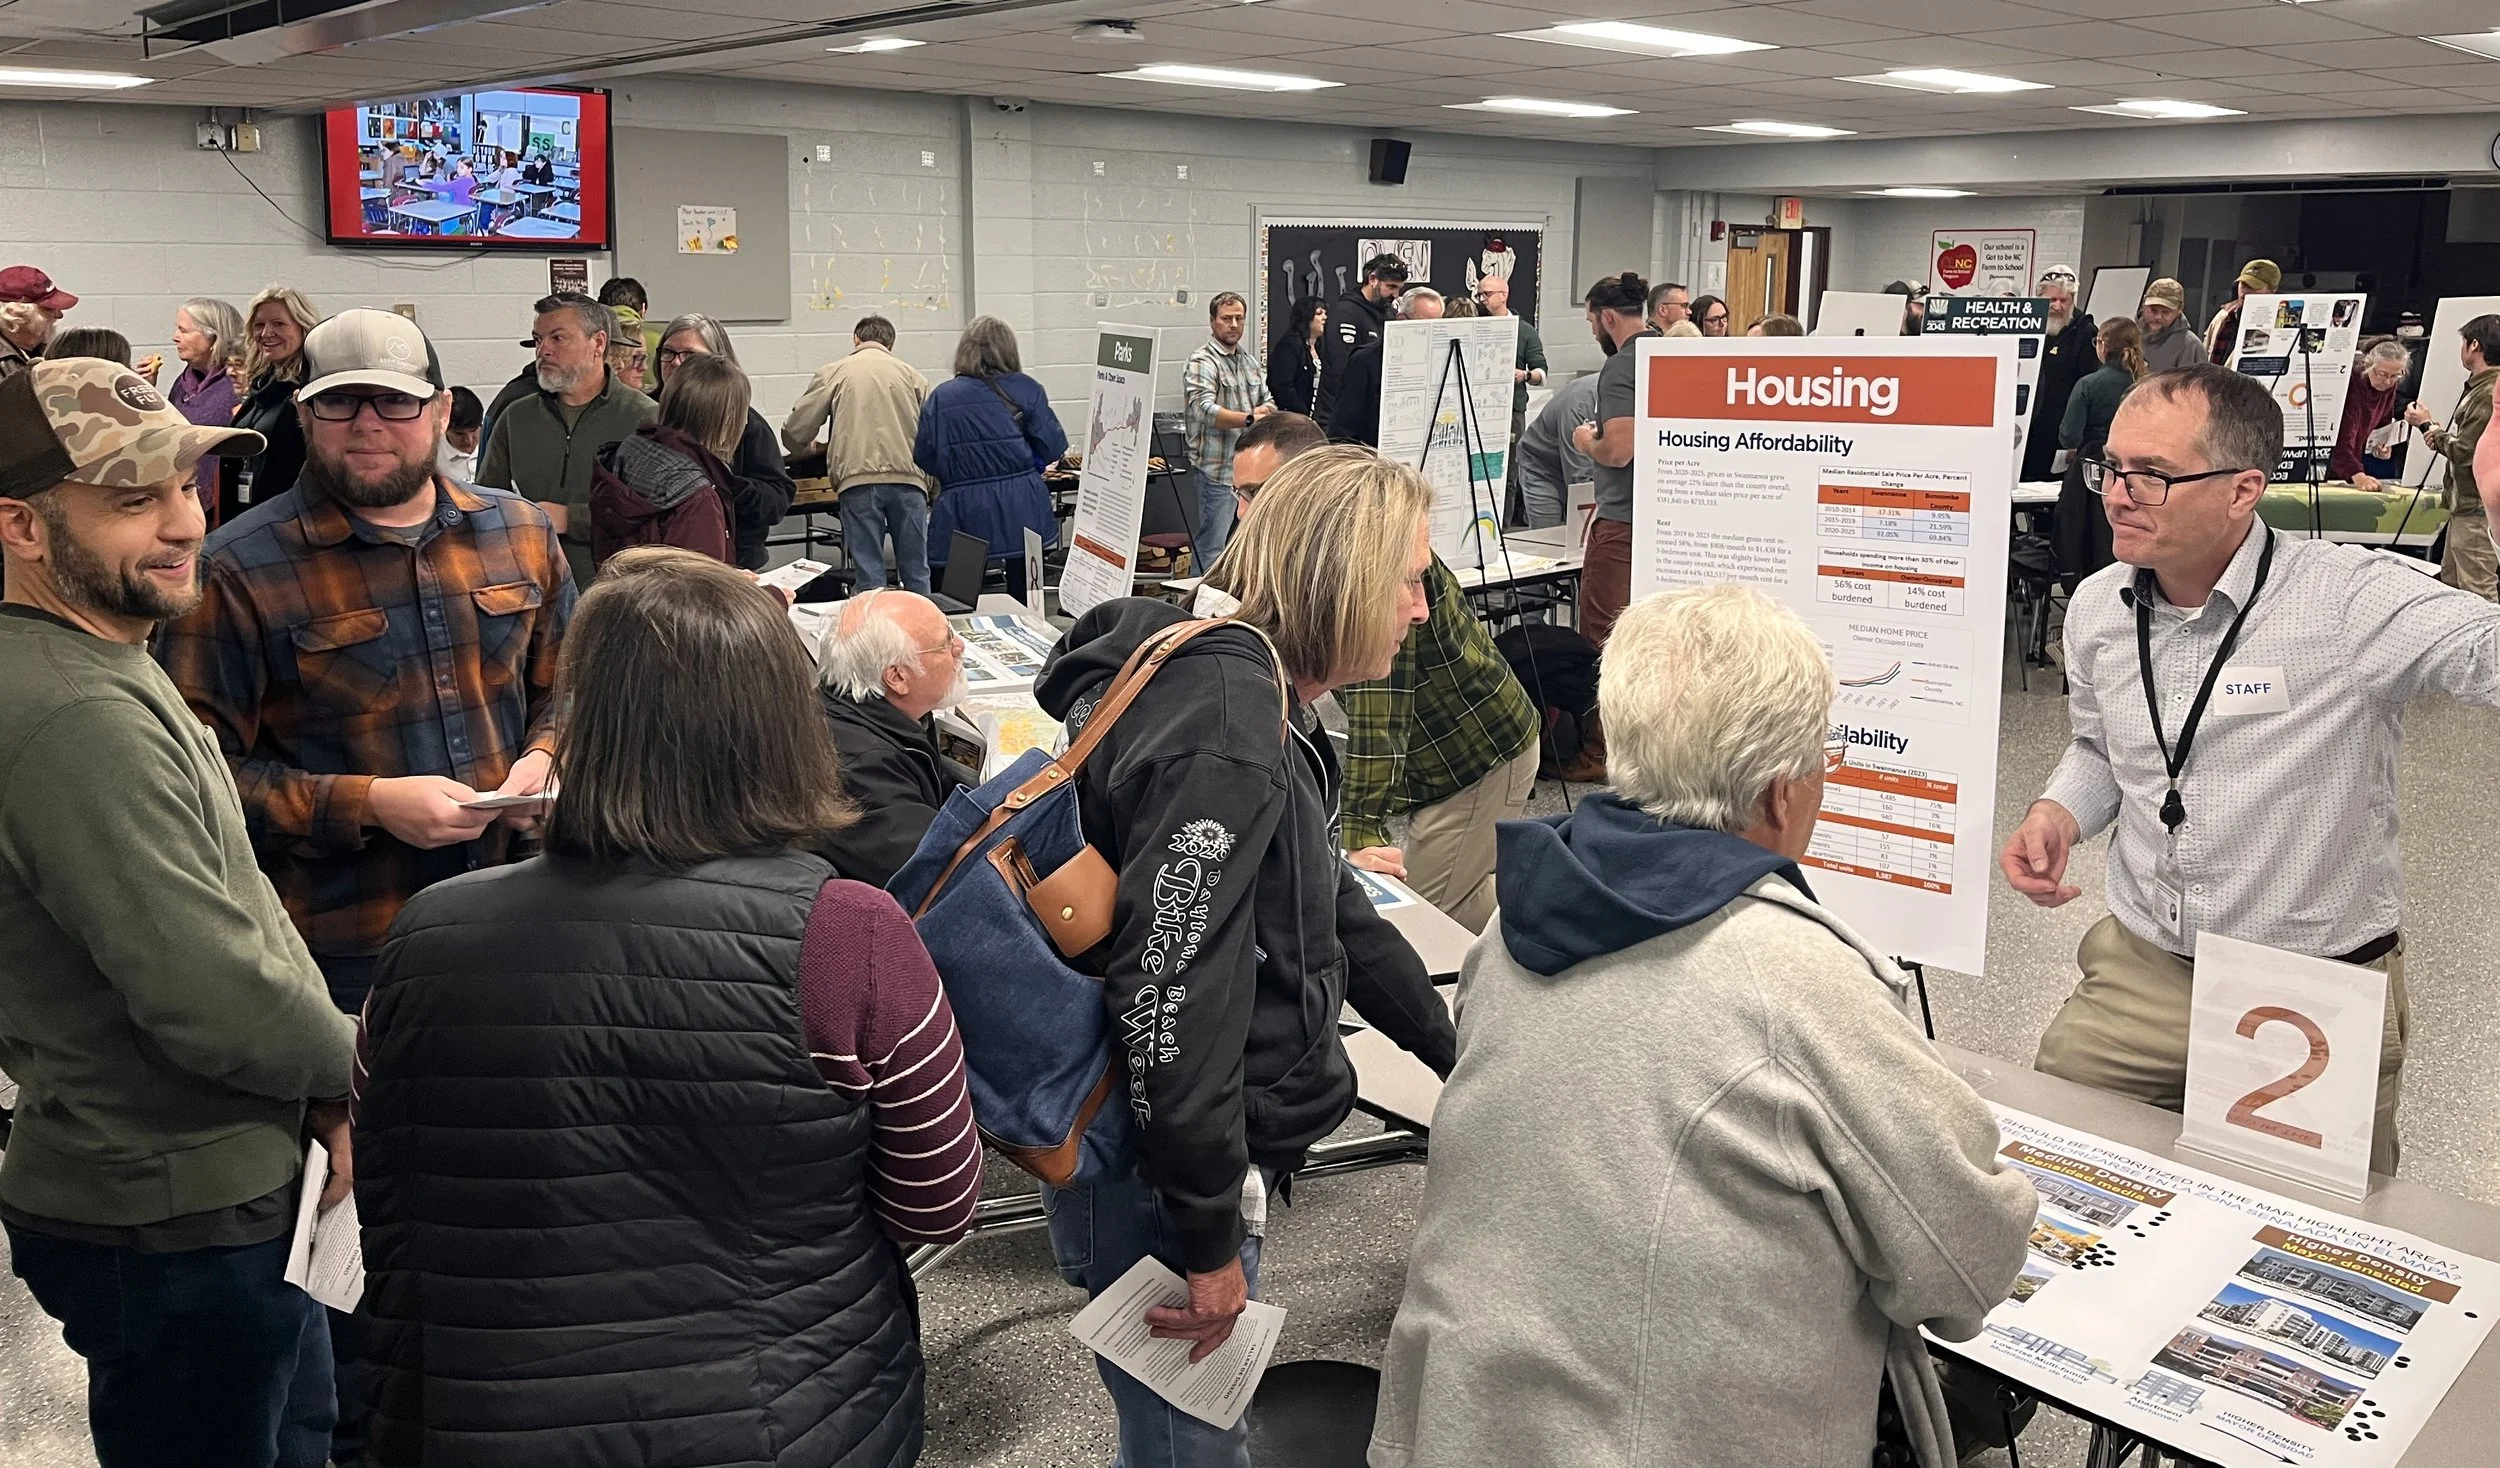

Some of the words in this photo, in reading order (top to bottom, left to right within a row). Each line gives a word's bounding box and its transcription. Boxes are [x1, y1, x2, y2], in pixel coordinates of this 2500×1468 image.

[1955, 259, 1972, 268] NC
[1965, 301, 2020, 314] HEALTH
[2022, 302, 2032, 314] &
[1952, 317, 2041, 329] RECREATION
[1114, 341, 1132, 363] Parks
[1727, 366, 1899, 416] Housing
[1658, 430, 1730, 451] Housing
[1735, 433, 1854, 456] Affordability
[1847, 469, 1880, 477] Residential
[1930, 503, 1953, 511] County
[1577, 504, 1596, 548] 7
[1823, 549, 1858, 557] Households
[1860, 552, 1886, 561] spending
[1905, 555, 1920, 563] than
[1862, 562, 1883, 570] income
[1894, 564, 1918, 573] housing
[1834, 579, 1852, 589] 56%
[1854, 582, 1872, 591] cost
[1907, 586, 1925, 596] 14%
[1927, 588, 1945, 598] cost
[1832, 592, 1873, 604] burdened
[1904, 600, 1947, 612] burdened
[1849, 623, 1879, 634] MEDIAN
[1880, 627, 1904, 637] HOME
[1905, 629, 1929, 639] PRICE
[1852, 635, 1873, 643] Owner
[1875, 637, 1906, 647] Occupied
[1907, 640, 1924, 649] Units
[2225, 682, 2272, 695] STAFF
[1840, 724, 1908, 754] lability
[1849, 759, 1865, 768] Units
[1872, 763, 1907, 774] Swannanoa
[1908, 769, 1928, 779] (2023)
[1884, 775, 1899, 783] units
[1934, 783, 1948, 791] total
[1141, 857, 1201, 975] Bike
[1176, 869, 1221, 974] Daytona
[1159, 984, 1186, 1063] Beach
[1121, 984, 1159, 1131] Week
[2225, 1006, 2330, 1150] 2
[2017, 1144, 2091, 1172] Medium
[2094, 1168, 2168, 1199] Density
[2022, 1156, 2096, 1182] Densidad
[2097, 1180, 2145, 1201] media
[2001, 1117, 2064, 1143] SHOULD
[2067, 1138, 2090, 1149] BE
[2092, 1147, 2194, 1185] PRIORITIZED
[2220, 1189, 2253, 1204] THE
[2256, 1203, 2294, 1217] MAP
[2294, 1215, 2397, 1247] HIGHLIGHT
[2398, 1246, 2460, 1270] AREA?
[2281, 1242, 2337, 1262] Mayor
[2340, 1259, 2424, 1293] densidad
[2286, 1234, 2353, 1257] Higher
[2355, 1254, 2432, 1286] Density
[2344, 1238, 2370, 1249] EN
[2373, 1246, 2393, 1258] EL
[2400, 1256, 2463, 1281] MAPA?
[2130, 1397, 2182, 1417] Apartment
[2216, 1415, 2255, 1433] MAYOR
[2256, 1432, 2314, 1459] DENSIDAD
[2223, 1411, 2266, 1430] HIGHER
[2266, 1430, 2316, 1452] DENSITY
